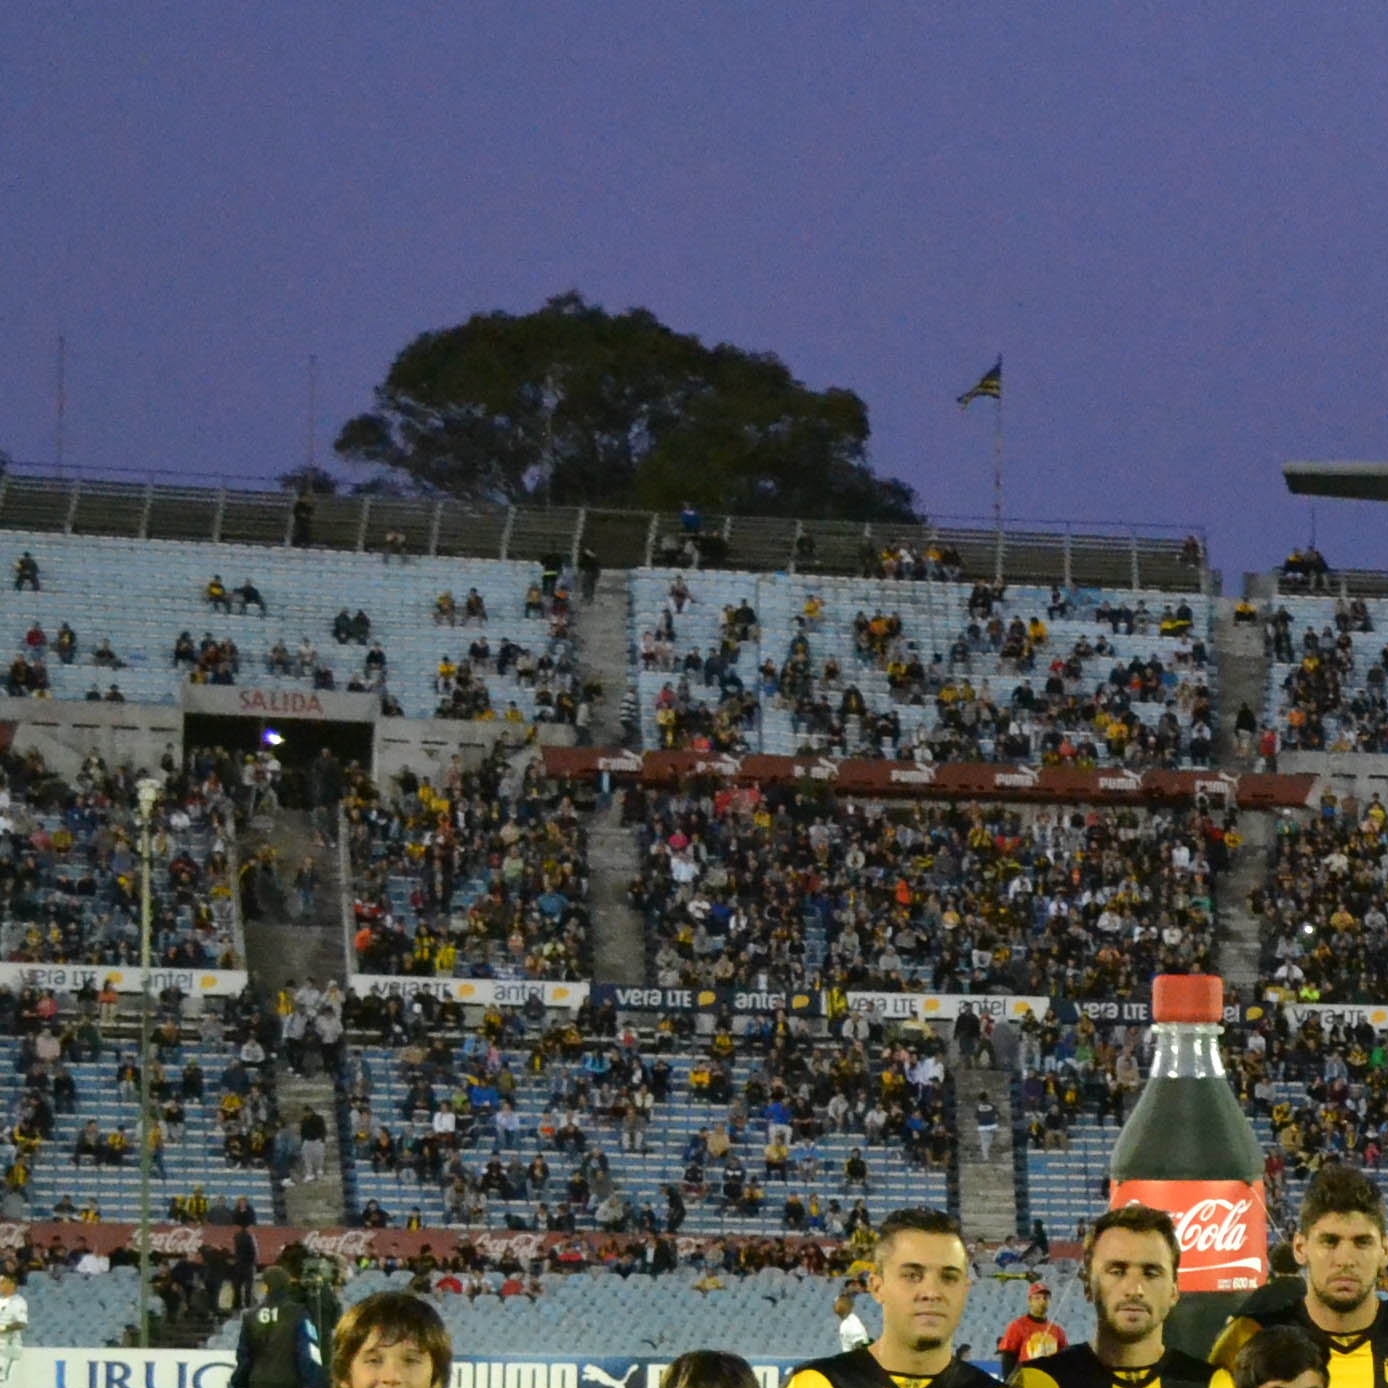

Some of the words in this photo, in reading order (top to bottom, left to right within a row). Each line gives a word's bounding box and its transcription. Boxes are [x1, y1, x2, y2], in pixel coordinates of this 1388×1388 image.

[239, 690, 325, 715] SALIDA
[995, 772, 1034, 787] PUMA
[1099, 776, 1138, 790] PUMA
[617, 988, 662, 1007] vera
[668, 988, 692, 1007] LTE
[893, 998, 918, 1014] LTE
[1124, 1001, 1148, 1020] LTE
[1168, 1198, 1252, 1252] -Cola
[129, 1227, 204, 1254] Cca-Cola
[258, 1306, 279, 1324] 61
